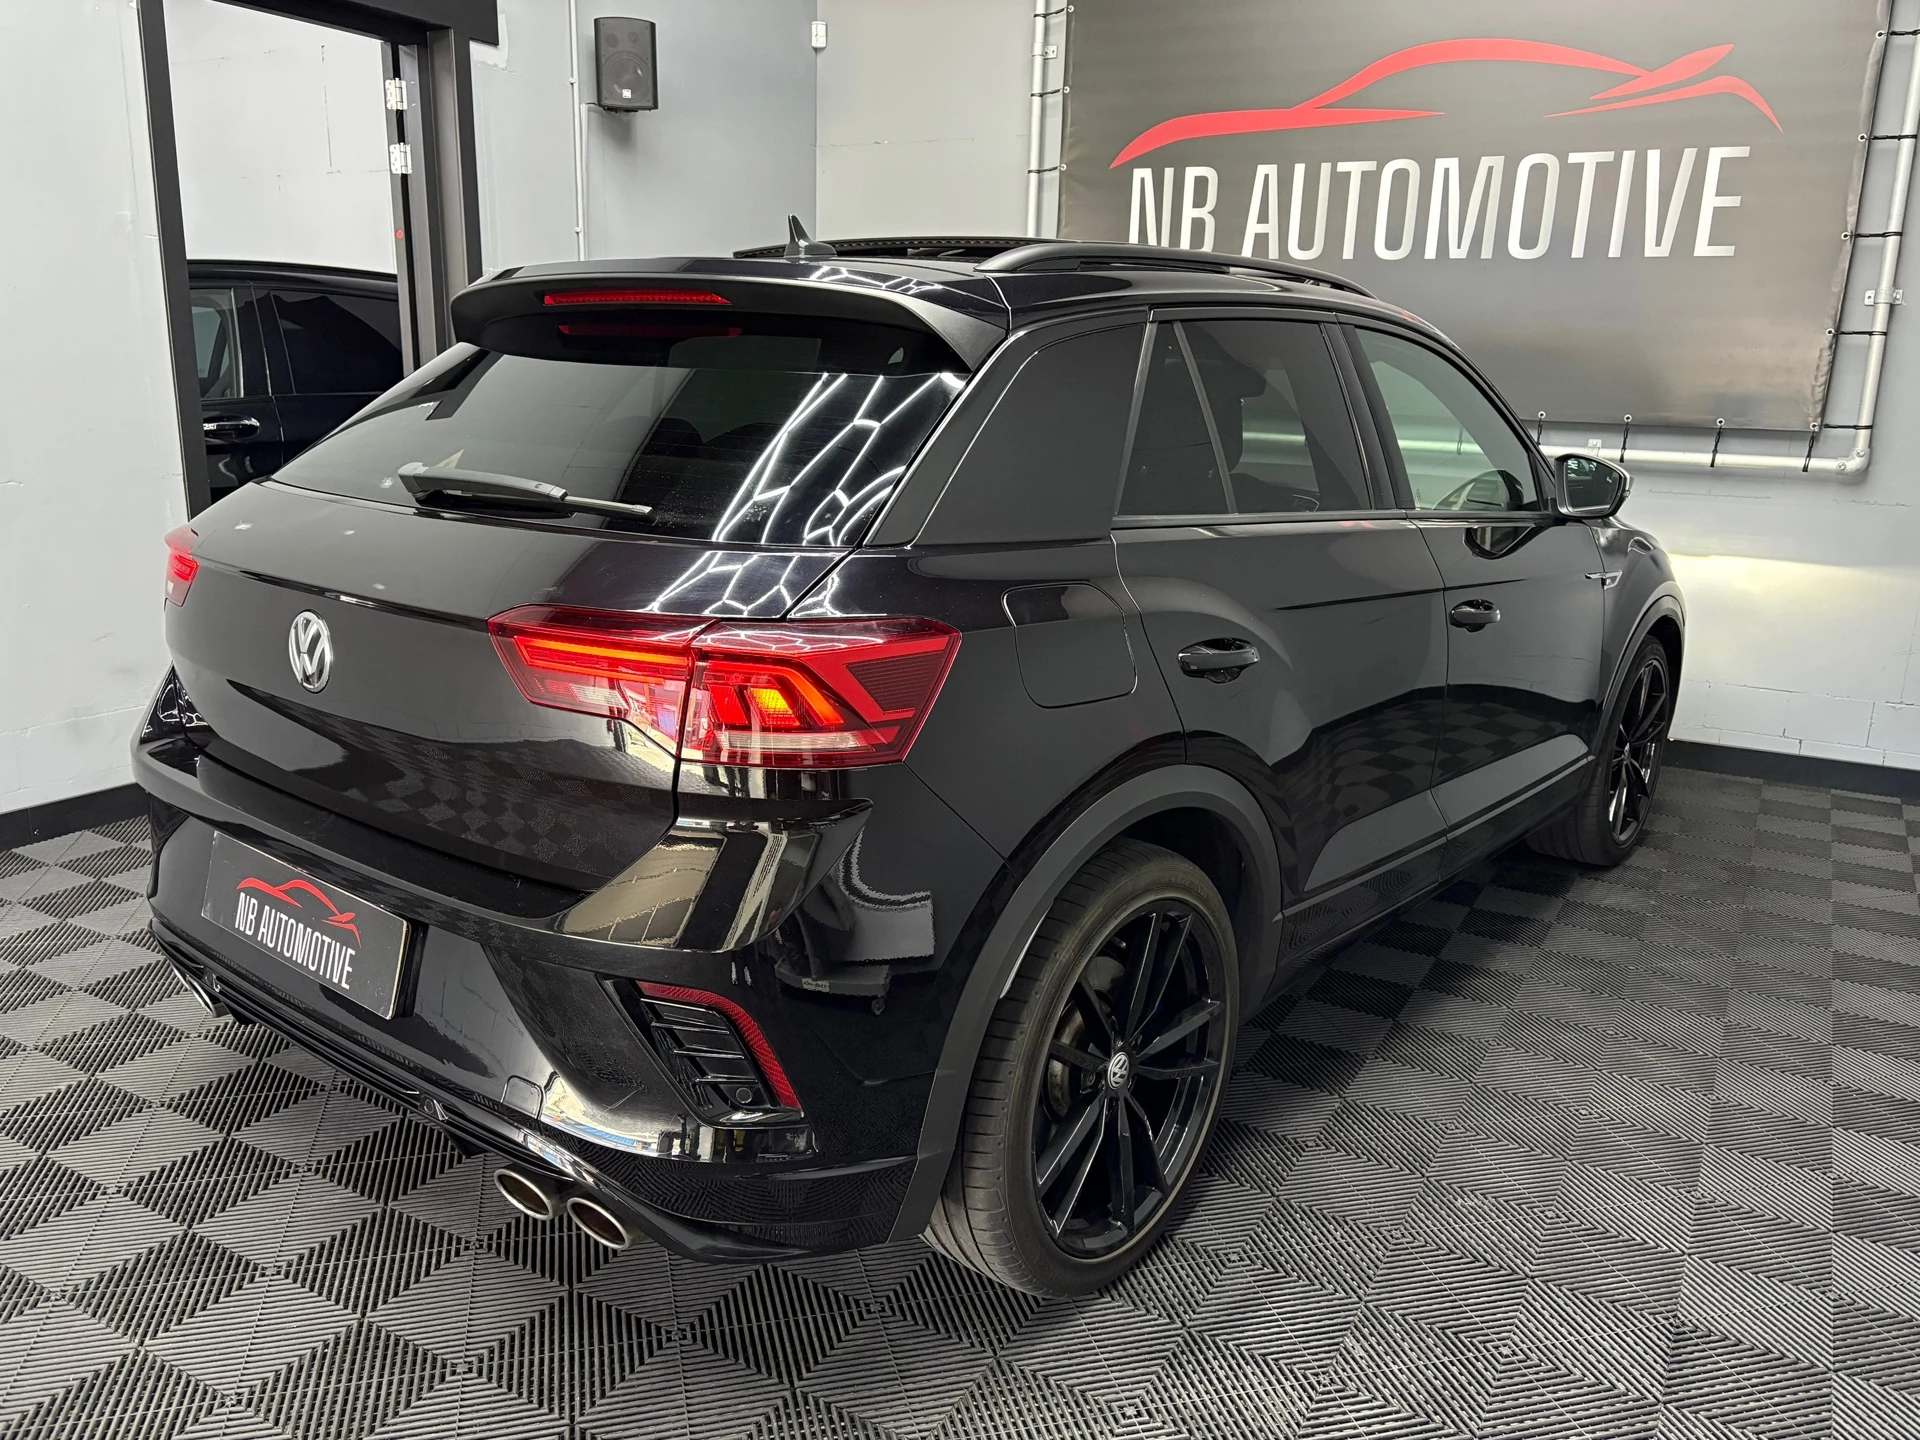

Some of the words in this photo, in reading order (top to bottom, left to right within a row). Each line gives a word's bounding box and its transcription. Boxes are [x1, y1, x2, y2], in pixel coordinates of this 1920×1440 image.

[1128, 166, 1219, 253] NB
[1241, 146, 1751, 261] AUTOMOTIVE
[234, 891, 258, 936] NB
[257, 904, 356, 990] AUTOMOTIVE
